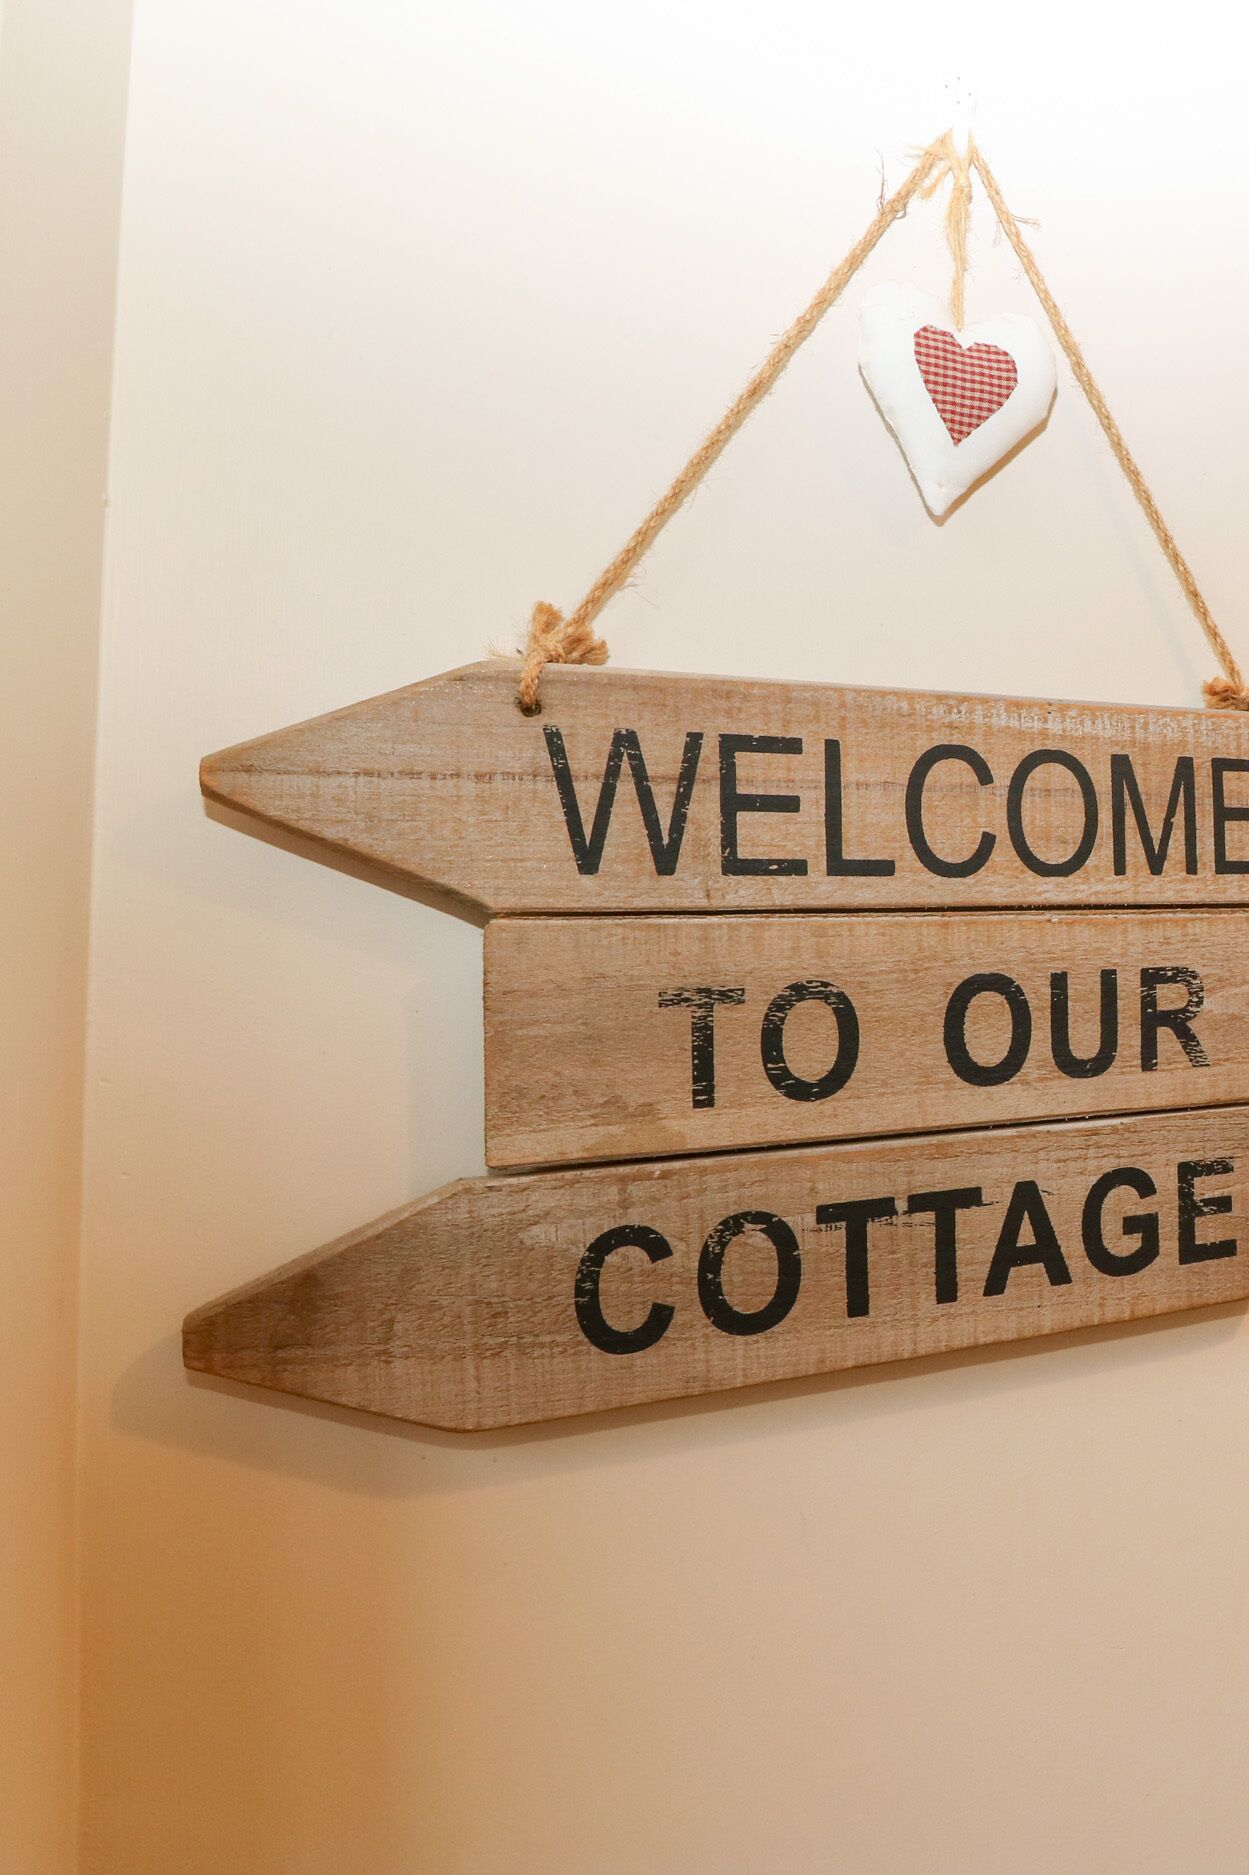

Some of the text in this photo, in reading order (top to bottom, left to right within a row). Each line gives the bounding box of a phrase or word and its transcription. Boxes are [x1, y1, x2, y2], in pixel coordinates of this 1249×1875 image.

[657, 966, 1209, 1109] TO OUR
[573, 1158, 1238, 1357] COTTAGE
